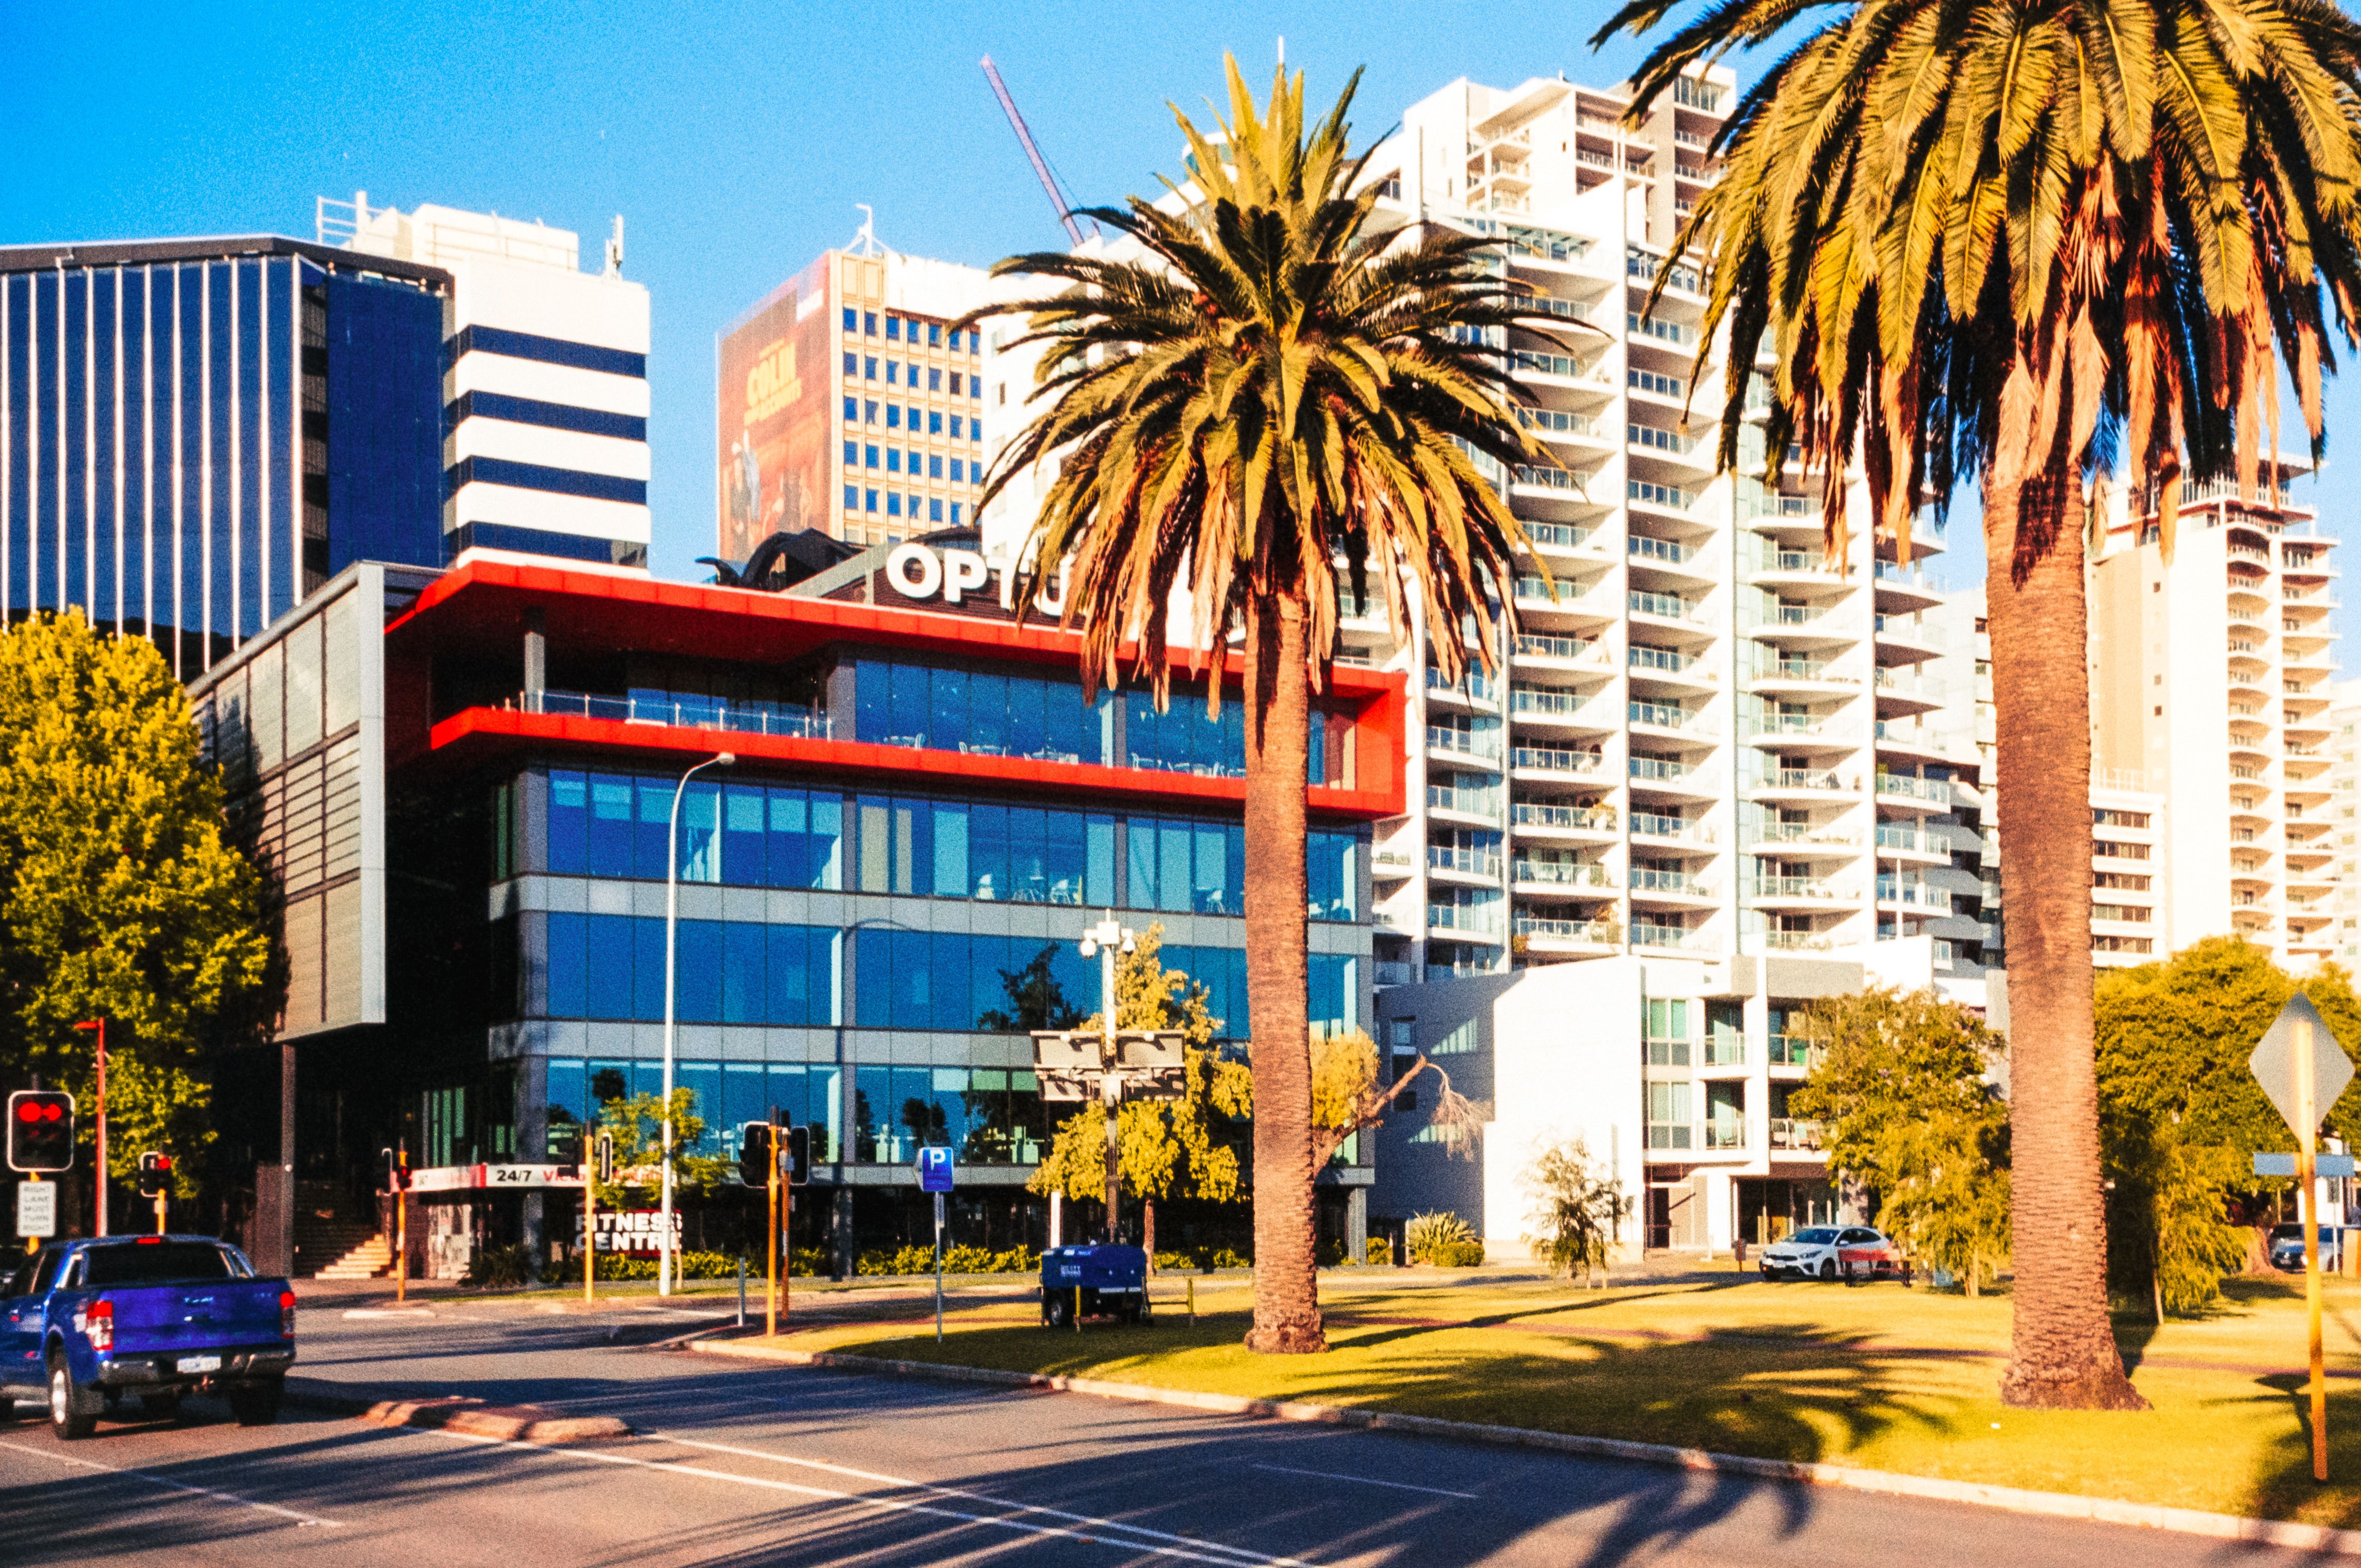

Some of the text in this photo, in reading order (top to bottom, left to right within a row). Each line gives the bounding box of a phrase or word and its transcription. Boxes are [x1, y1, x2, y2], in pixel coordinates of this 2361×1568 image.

[886, 543, 1087, 617] OPTU
[930, 1149, 946, 1171] P
[497, 1170, 532, 1182] 24/7
